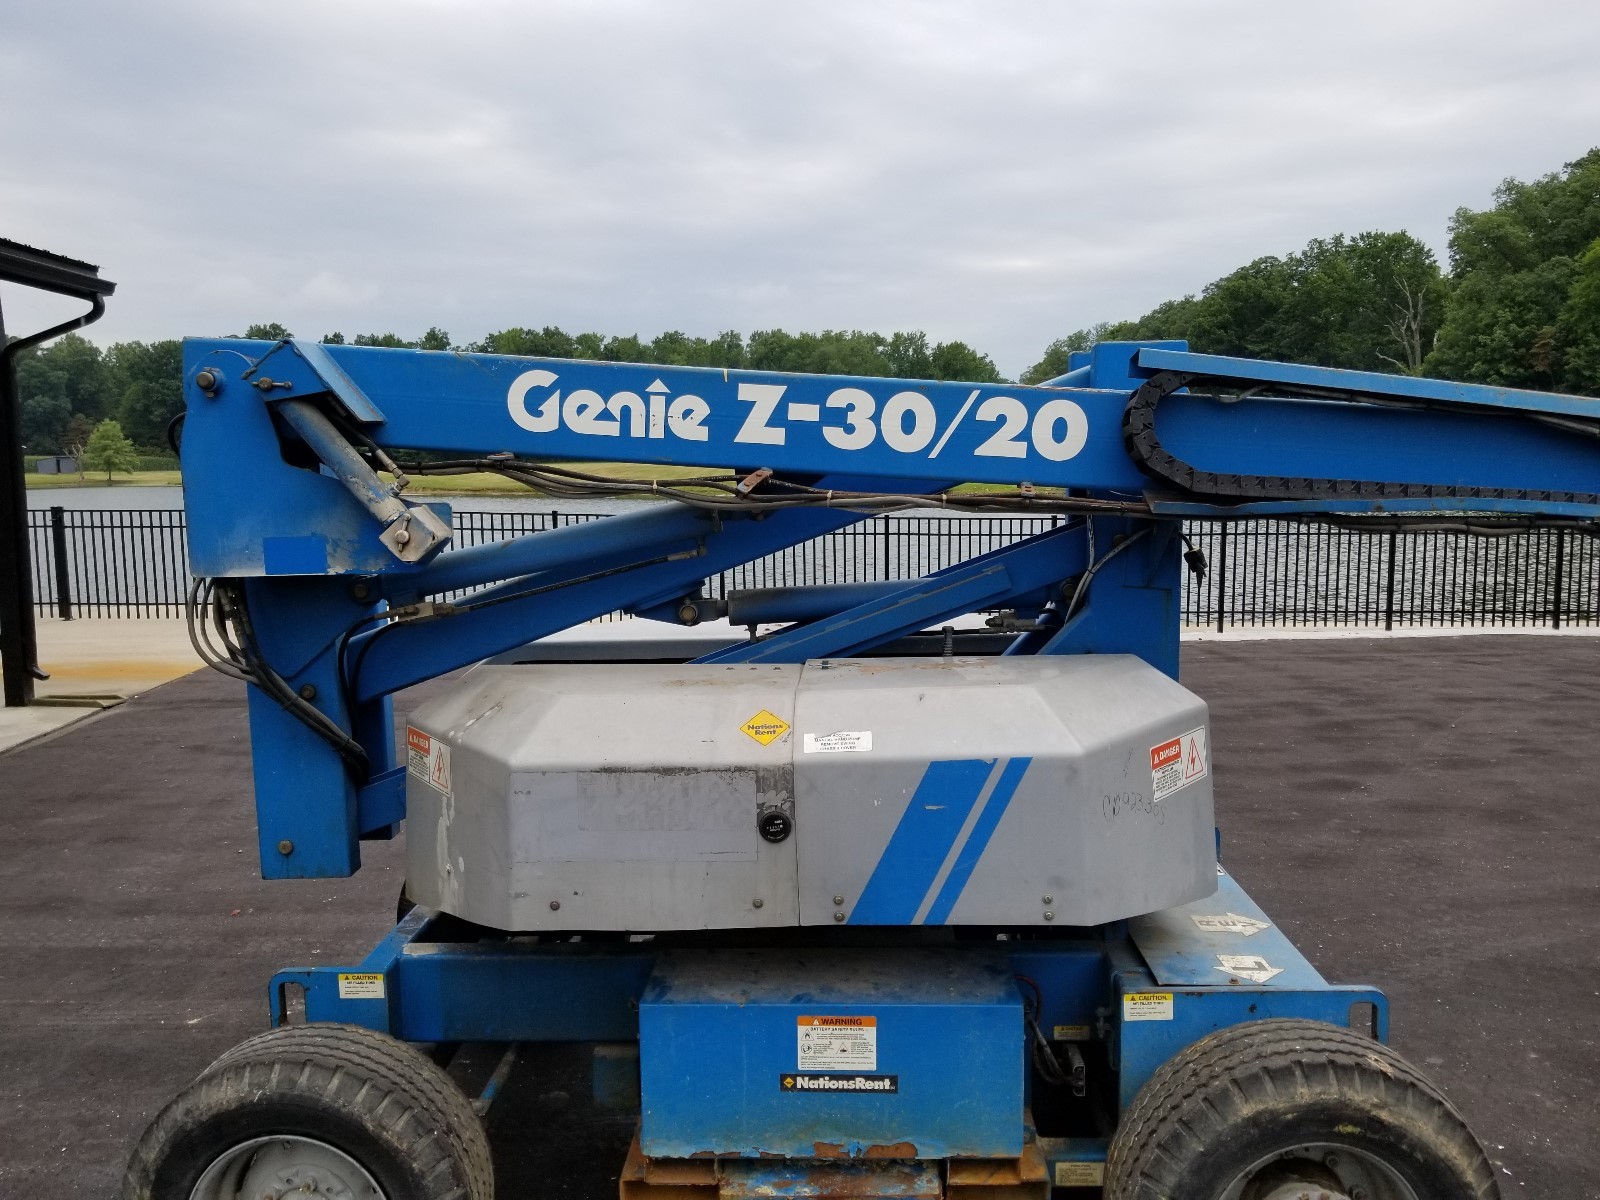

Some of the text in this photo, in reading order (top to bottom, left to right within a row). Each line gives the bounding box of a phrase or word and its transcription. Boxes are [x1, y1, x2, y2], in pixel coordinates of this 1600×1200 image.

[507, 369, 1089, 461] Genie Z-30/20
[1159, 744, 1180, 761] DANGER
[821, 1018, 862, 1026] WARNING
[796, 1076, 891, 1090] NationsRent
